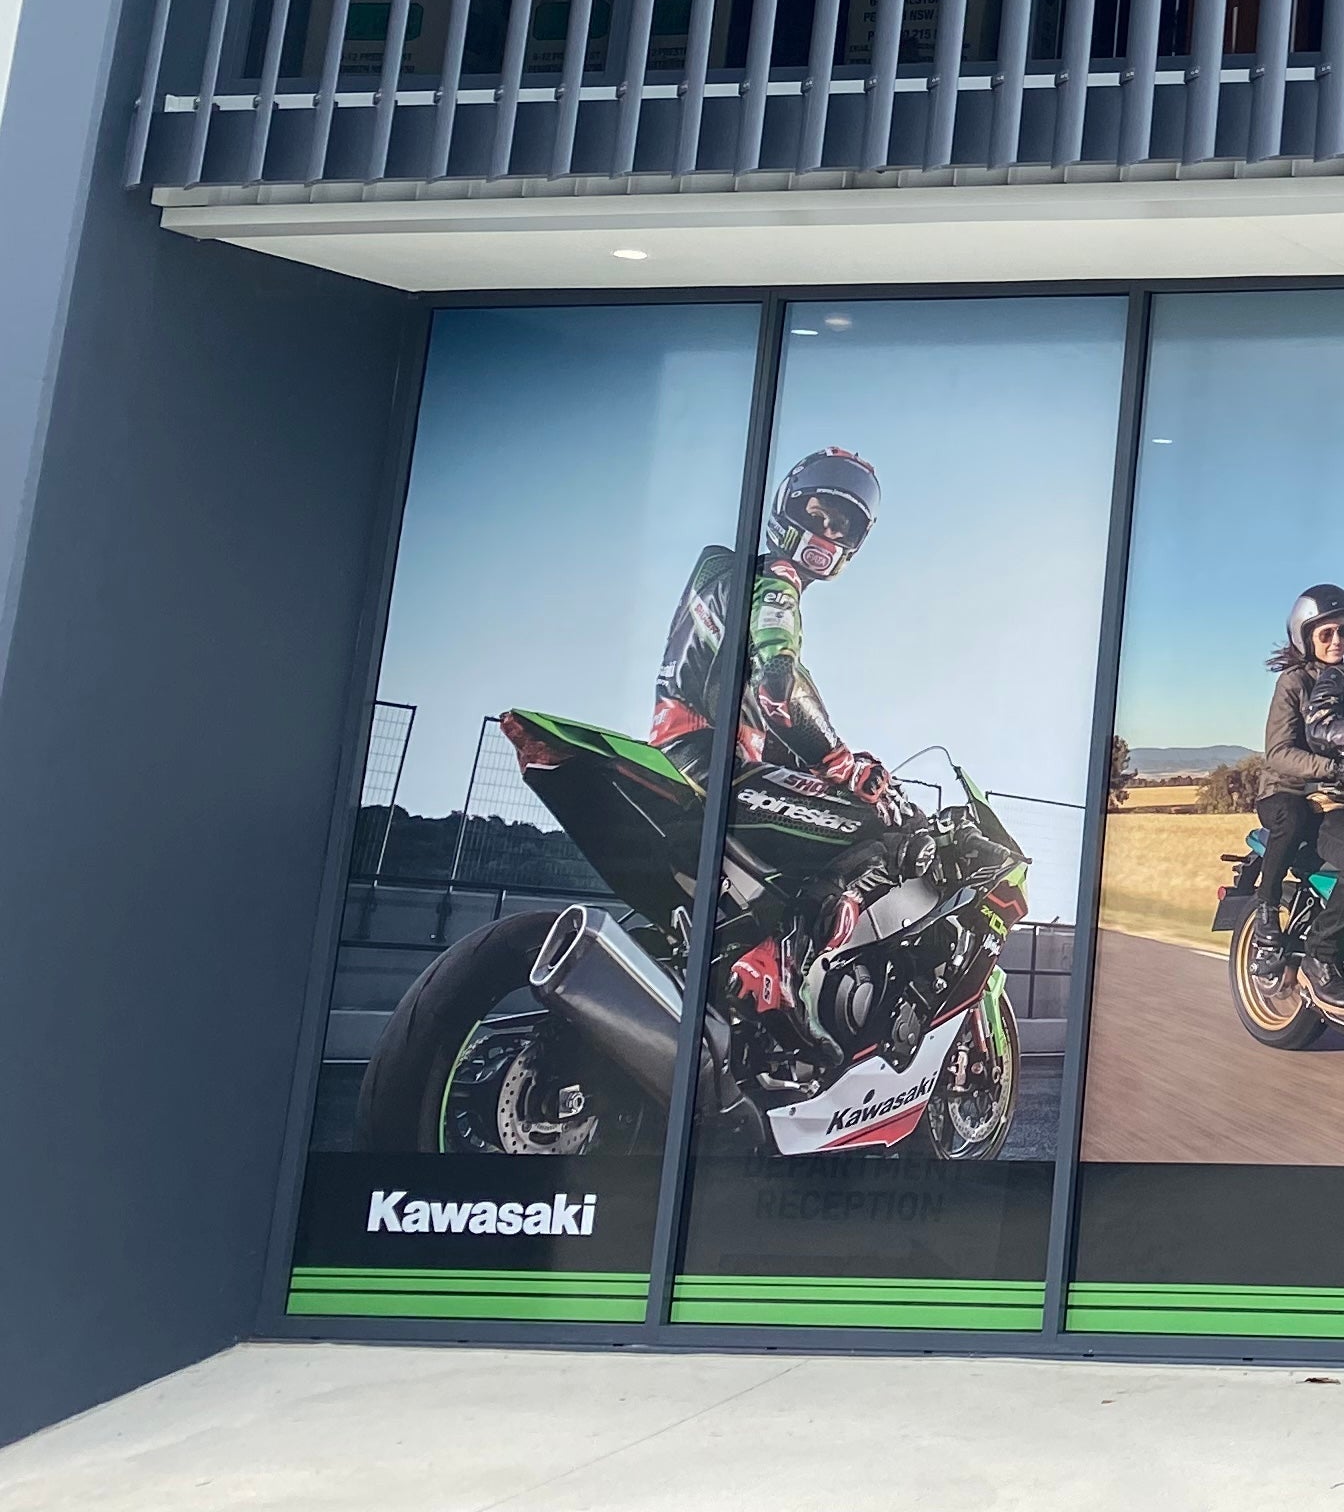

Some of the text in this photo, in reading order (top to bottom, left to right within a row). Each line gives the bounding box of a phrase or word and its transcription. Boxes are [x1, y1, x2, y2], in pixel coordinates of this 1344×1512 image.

[738, 788, 861, 833] alpinestars
[826, 1071, 938, 1135] Kawasaki
[366, 1190, 598, 1237] Kawasaki
